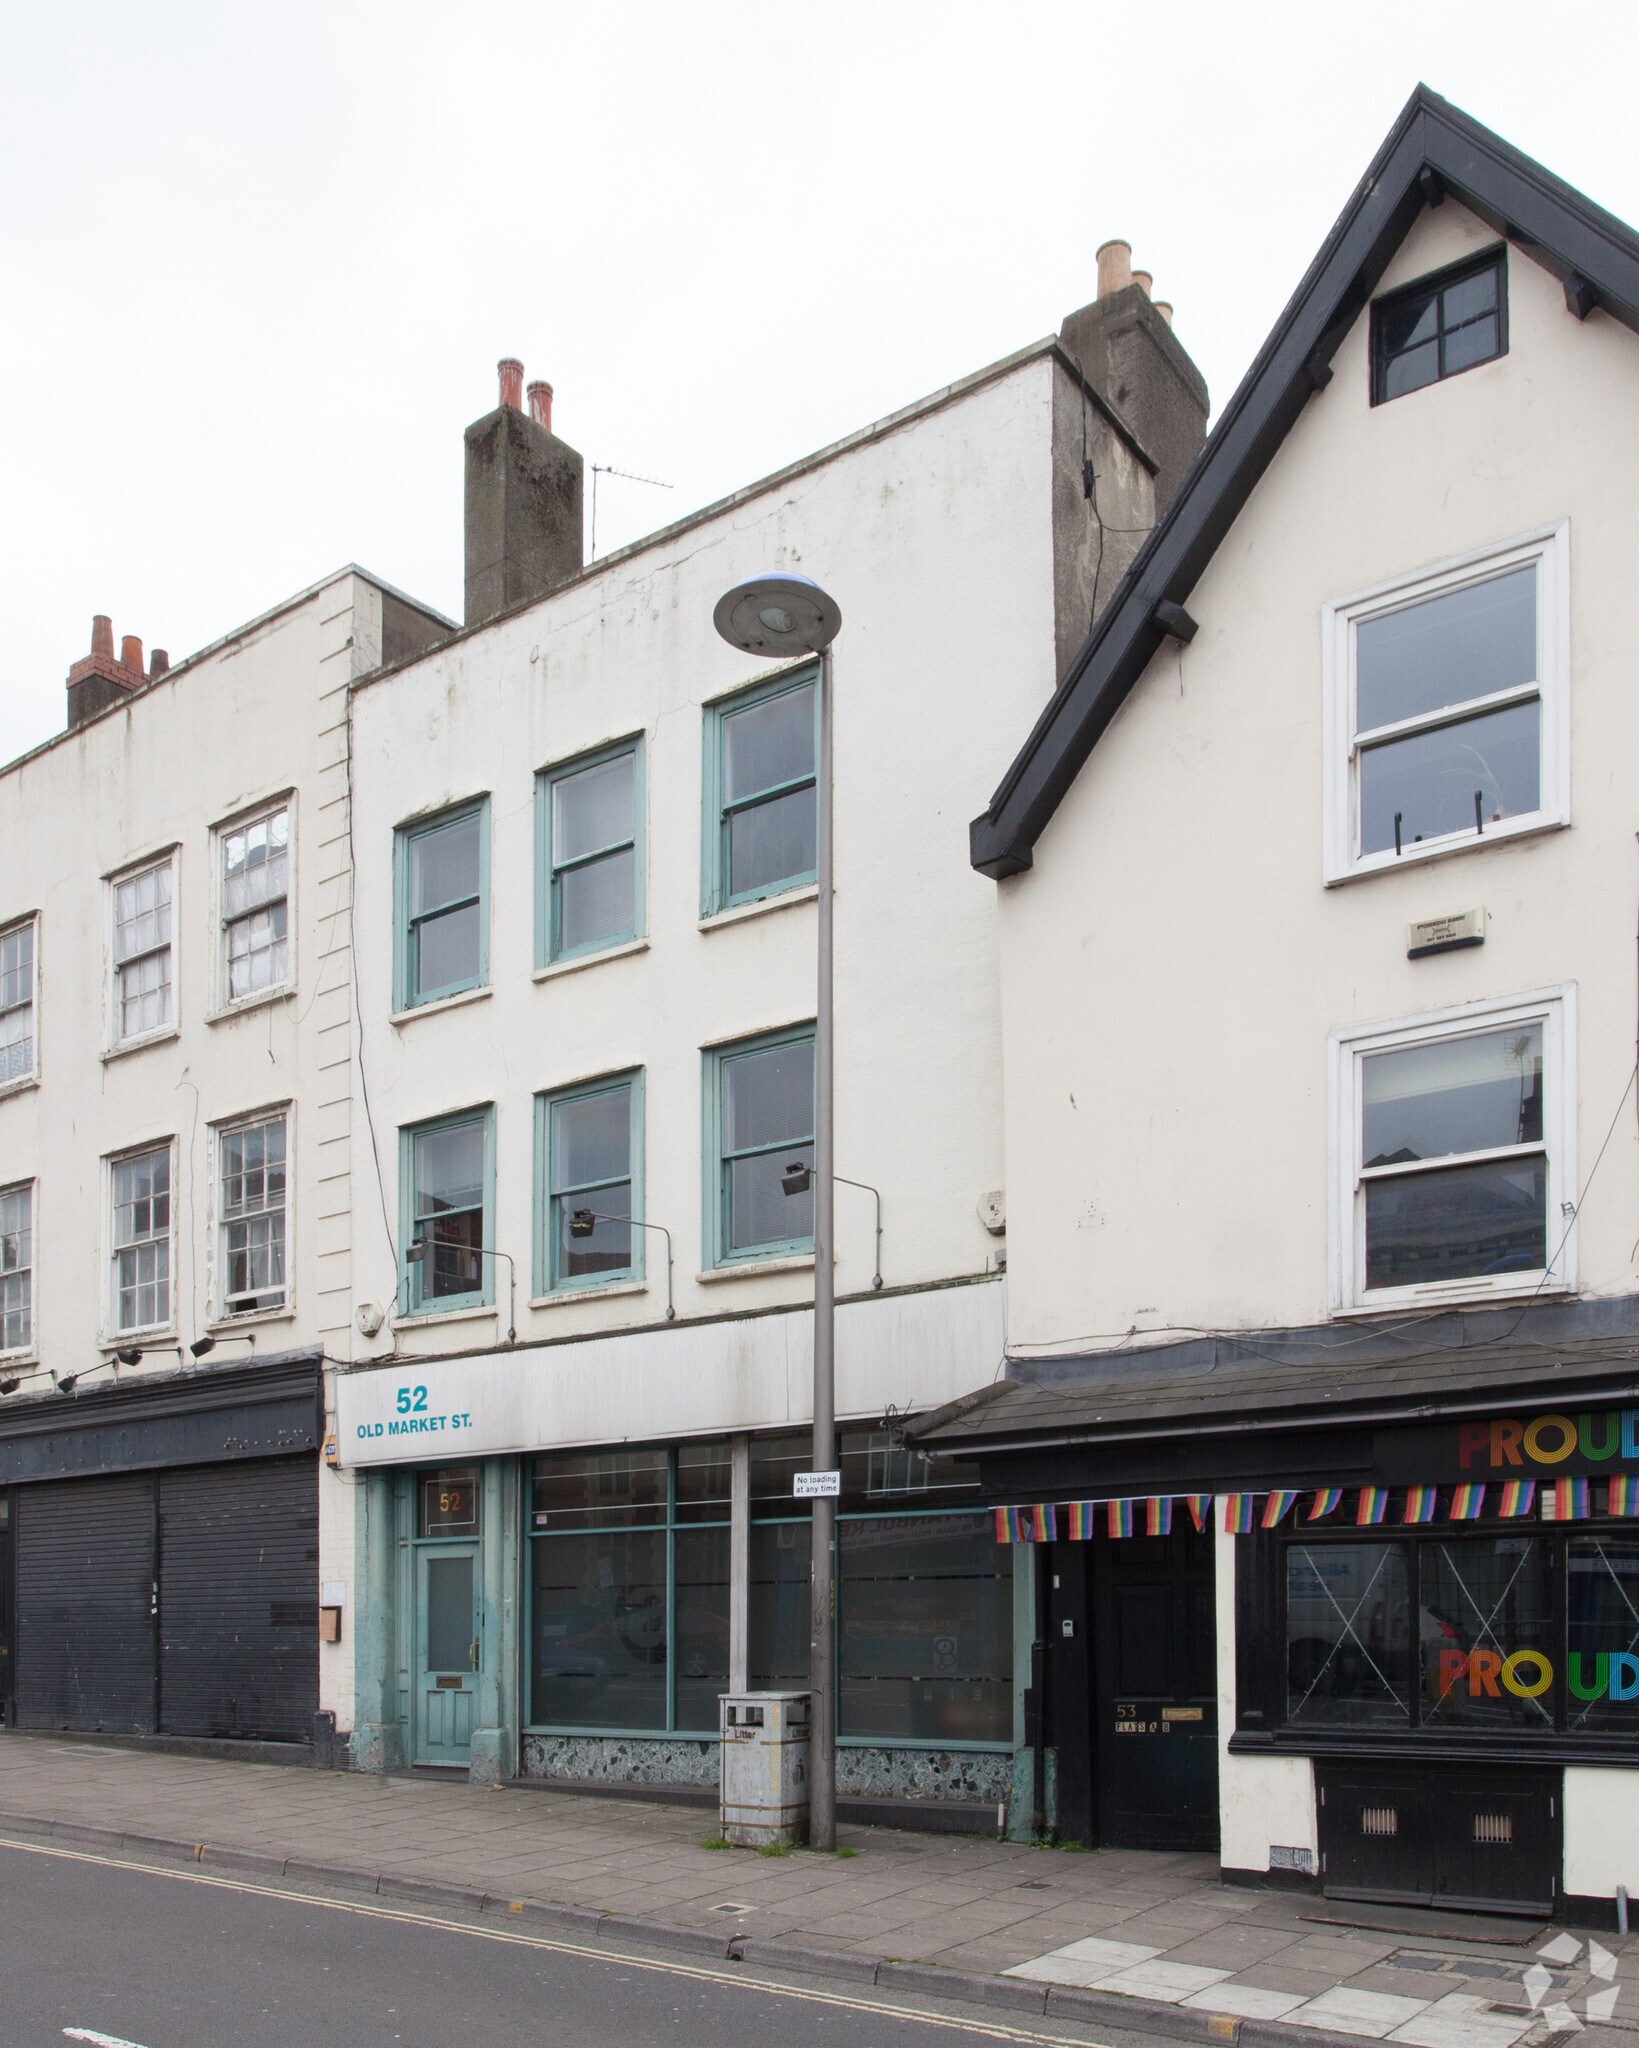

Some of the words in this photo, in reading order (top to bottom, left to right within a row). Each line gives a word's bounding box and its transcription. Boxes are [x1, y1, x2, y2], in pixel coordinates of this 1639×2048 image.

[396, 1385, 428, 1414] 52
[357, 1423, 384, 1439] OLD
[388, 1416, 447, 1436] MARKET
[451, 1413, 473, 1429] ST.
[797, 1476, 808, 1484] No
[809, 1475, 837, 1484] loading
[805, 1486, 819, 1494] any
[439, 1492, 460, 1512] 52
[1439, 1649, 1639, 1701] PROUD
[1117, 1704, 1137, 1718] 53
[1116, 1722, 1146, 1732] FLATS
[1162, 1722, 1169, 1732] B
[735, 1729, 757, 1740] Litter
